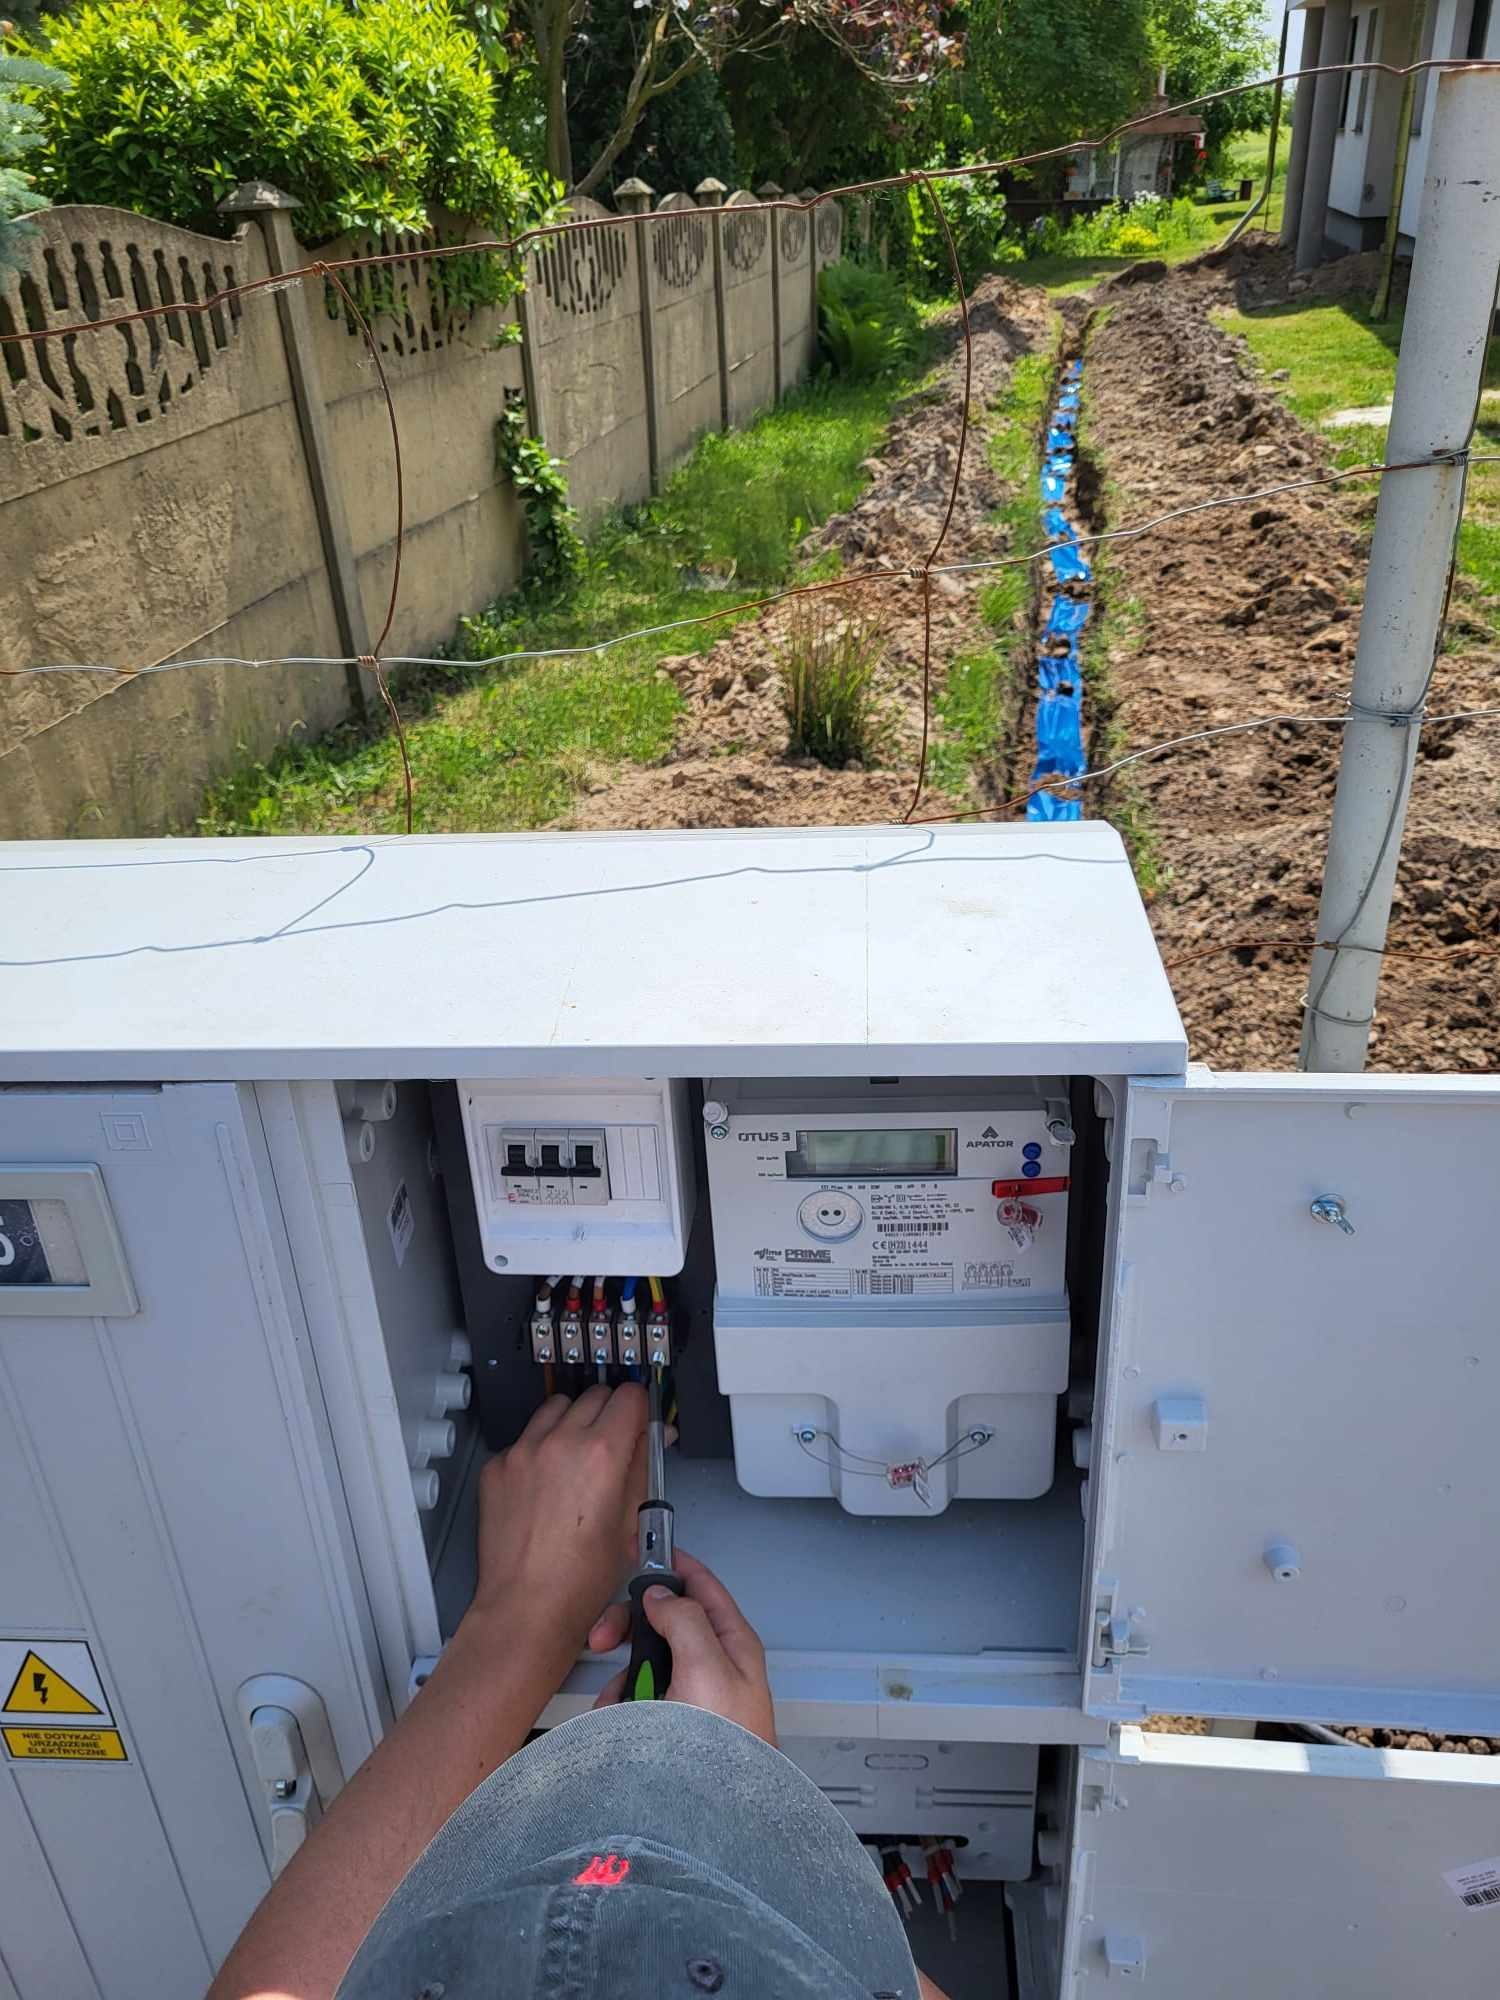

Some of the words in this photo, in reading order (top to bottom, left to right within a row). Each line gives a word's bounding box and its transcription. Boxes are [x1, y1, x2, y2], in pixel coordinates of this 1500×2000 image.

[781, 1132, 791, 1142] 3
[966, 1140, 1014, 1149] APATOR
[785, 1249, 831, 1258] PRIME
[22, 1732, 41, 1740] NIE
[28, 1747, 107, 1756] ELEKTRYCZNE
